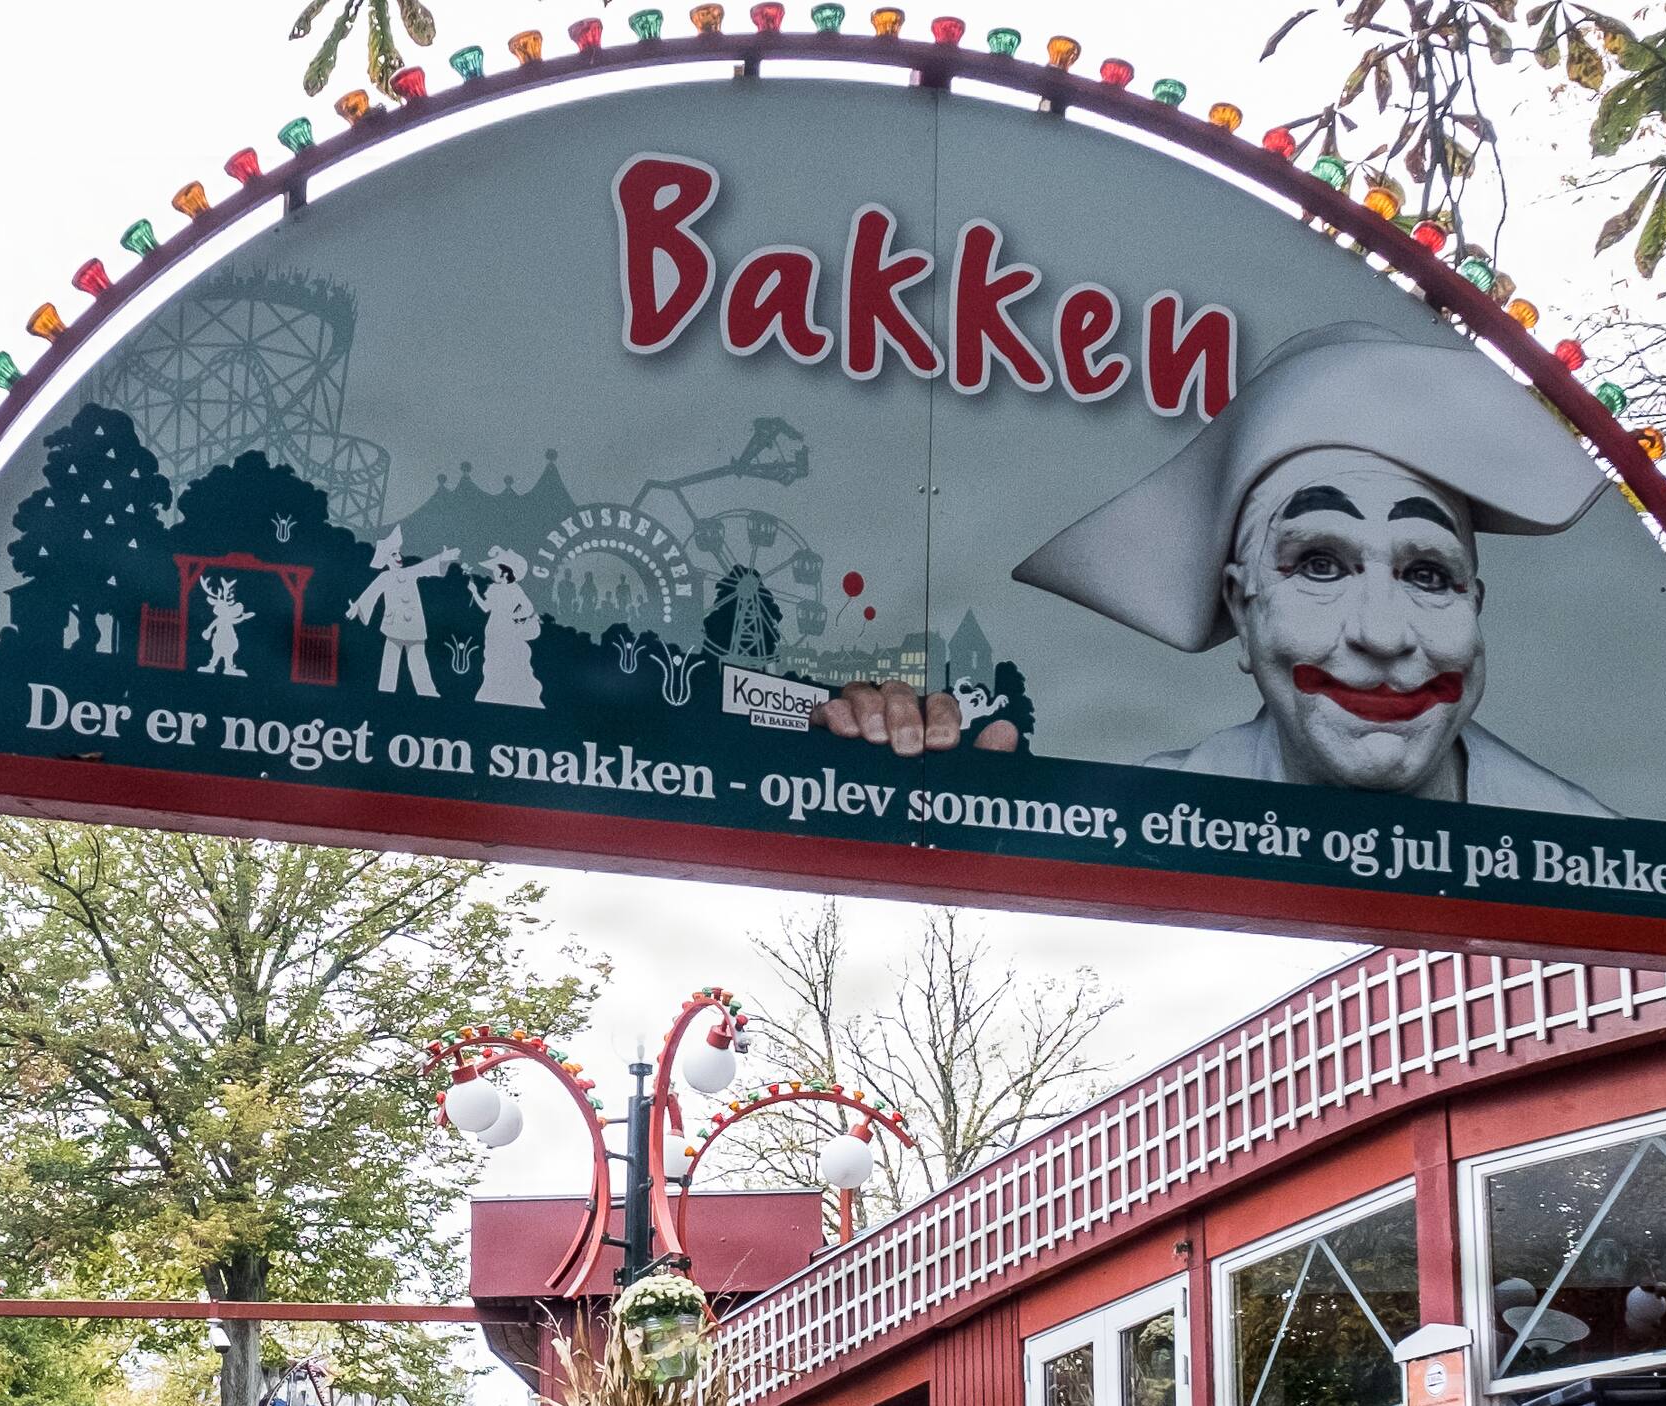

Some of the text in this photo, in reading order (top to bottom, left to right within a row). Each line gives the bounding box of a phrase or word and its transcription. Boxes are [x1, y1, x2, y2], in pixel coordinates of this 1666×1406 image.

[616, 156, 1233, 421] Bakken
[26, 683, 131, 737] Der
[146, 709, 206, 745] er
[221, 715, 374, 770] noget
[388, 734, 475, 774] om
[488, 741, 716, 799] snakken
[761, 768, 895, 821] oplev
[907, 789, 1127, 848] sommer,
[1141, 803, 1311, 858] efterår
[1323, 825, 1380, 877] og
[1385, 826, 1452, 879] jul
[1464, 834, 1521, 887] på
[769, 717, 807, 729] BAKKEN
